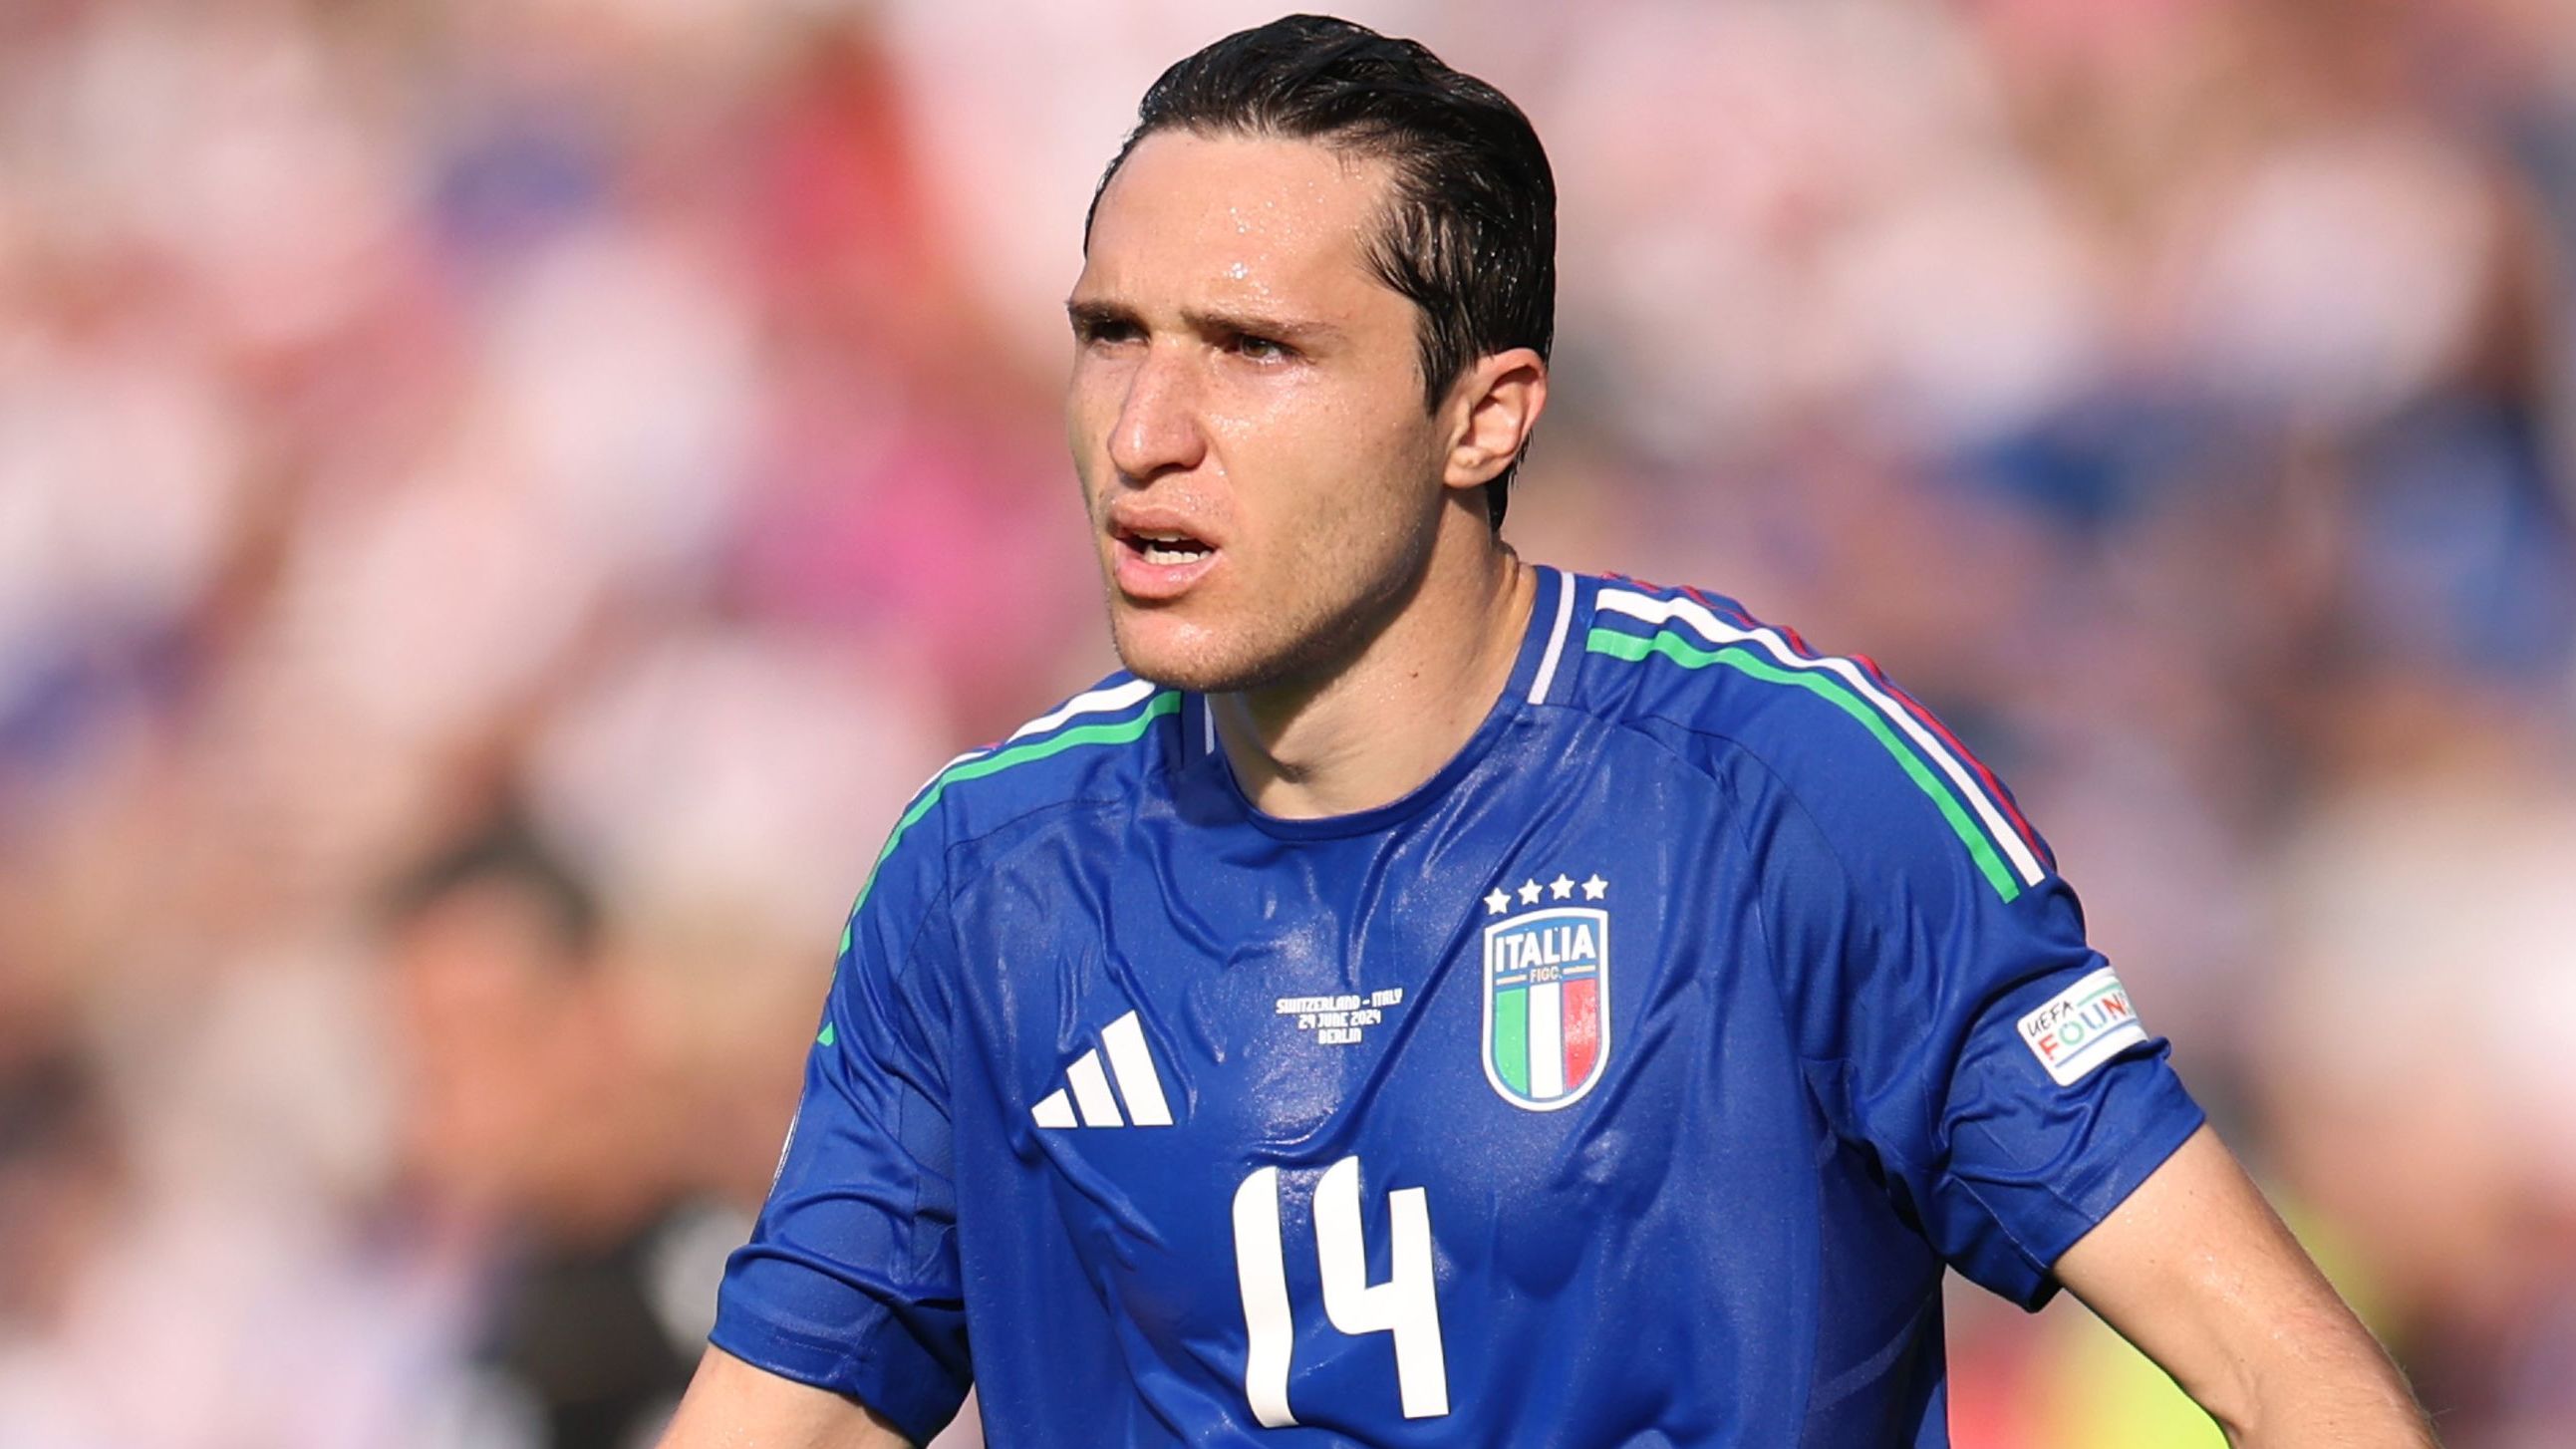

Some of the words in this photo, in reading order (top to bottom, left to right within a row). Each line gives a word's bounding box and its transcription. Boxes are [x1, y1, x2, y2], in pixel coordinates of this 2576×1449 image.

[1496, 924, 1596, 973] ITALIA
[1276, 996, 1360, 1014] SWITZERLAND
[1371, 988, 1403, 1007] ITALY
[1298, 1014, 1315, 1029] 24
[1318, 1013, 1348, 1027] JUNE
[1350, 1010, 1381, 1025] 2024
[2027, 1001, 2074, 1036] UEFA
[1318, 1027, 1362, 1044] BERLIN
[1233, 1156, 1449, 1428] 14
